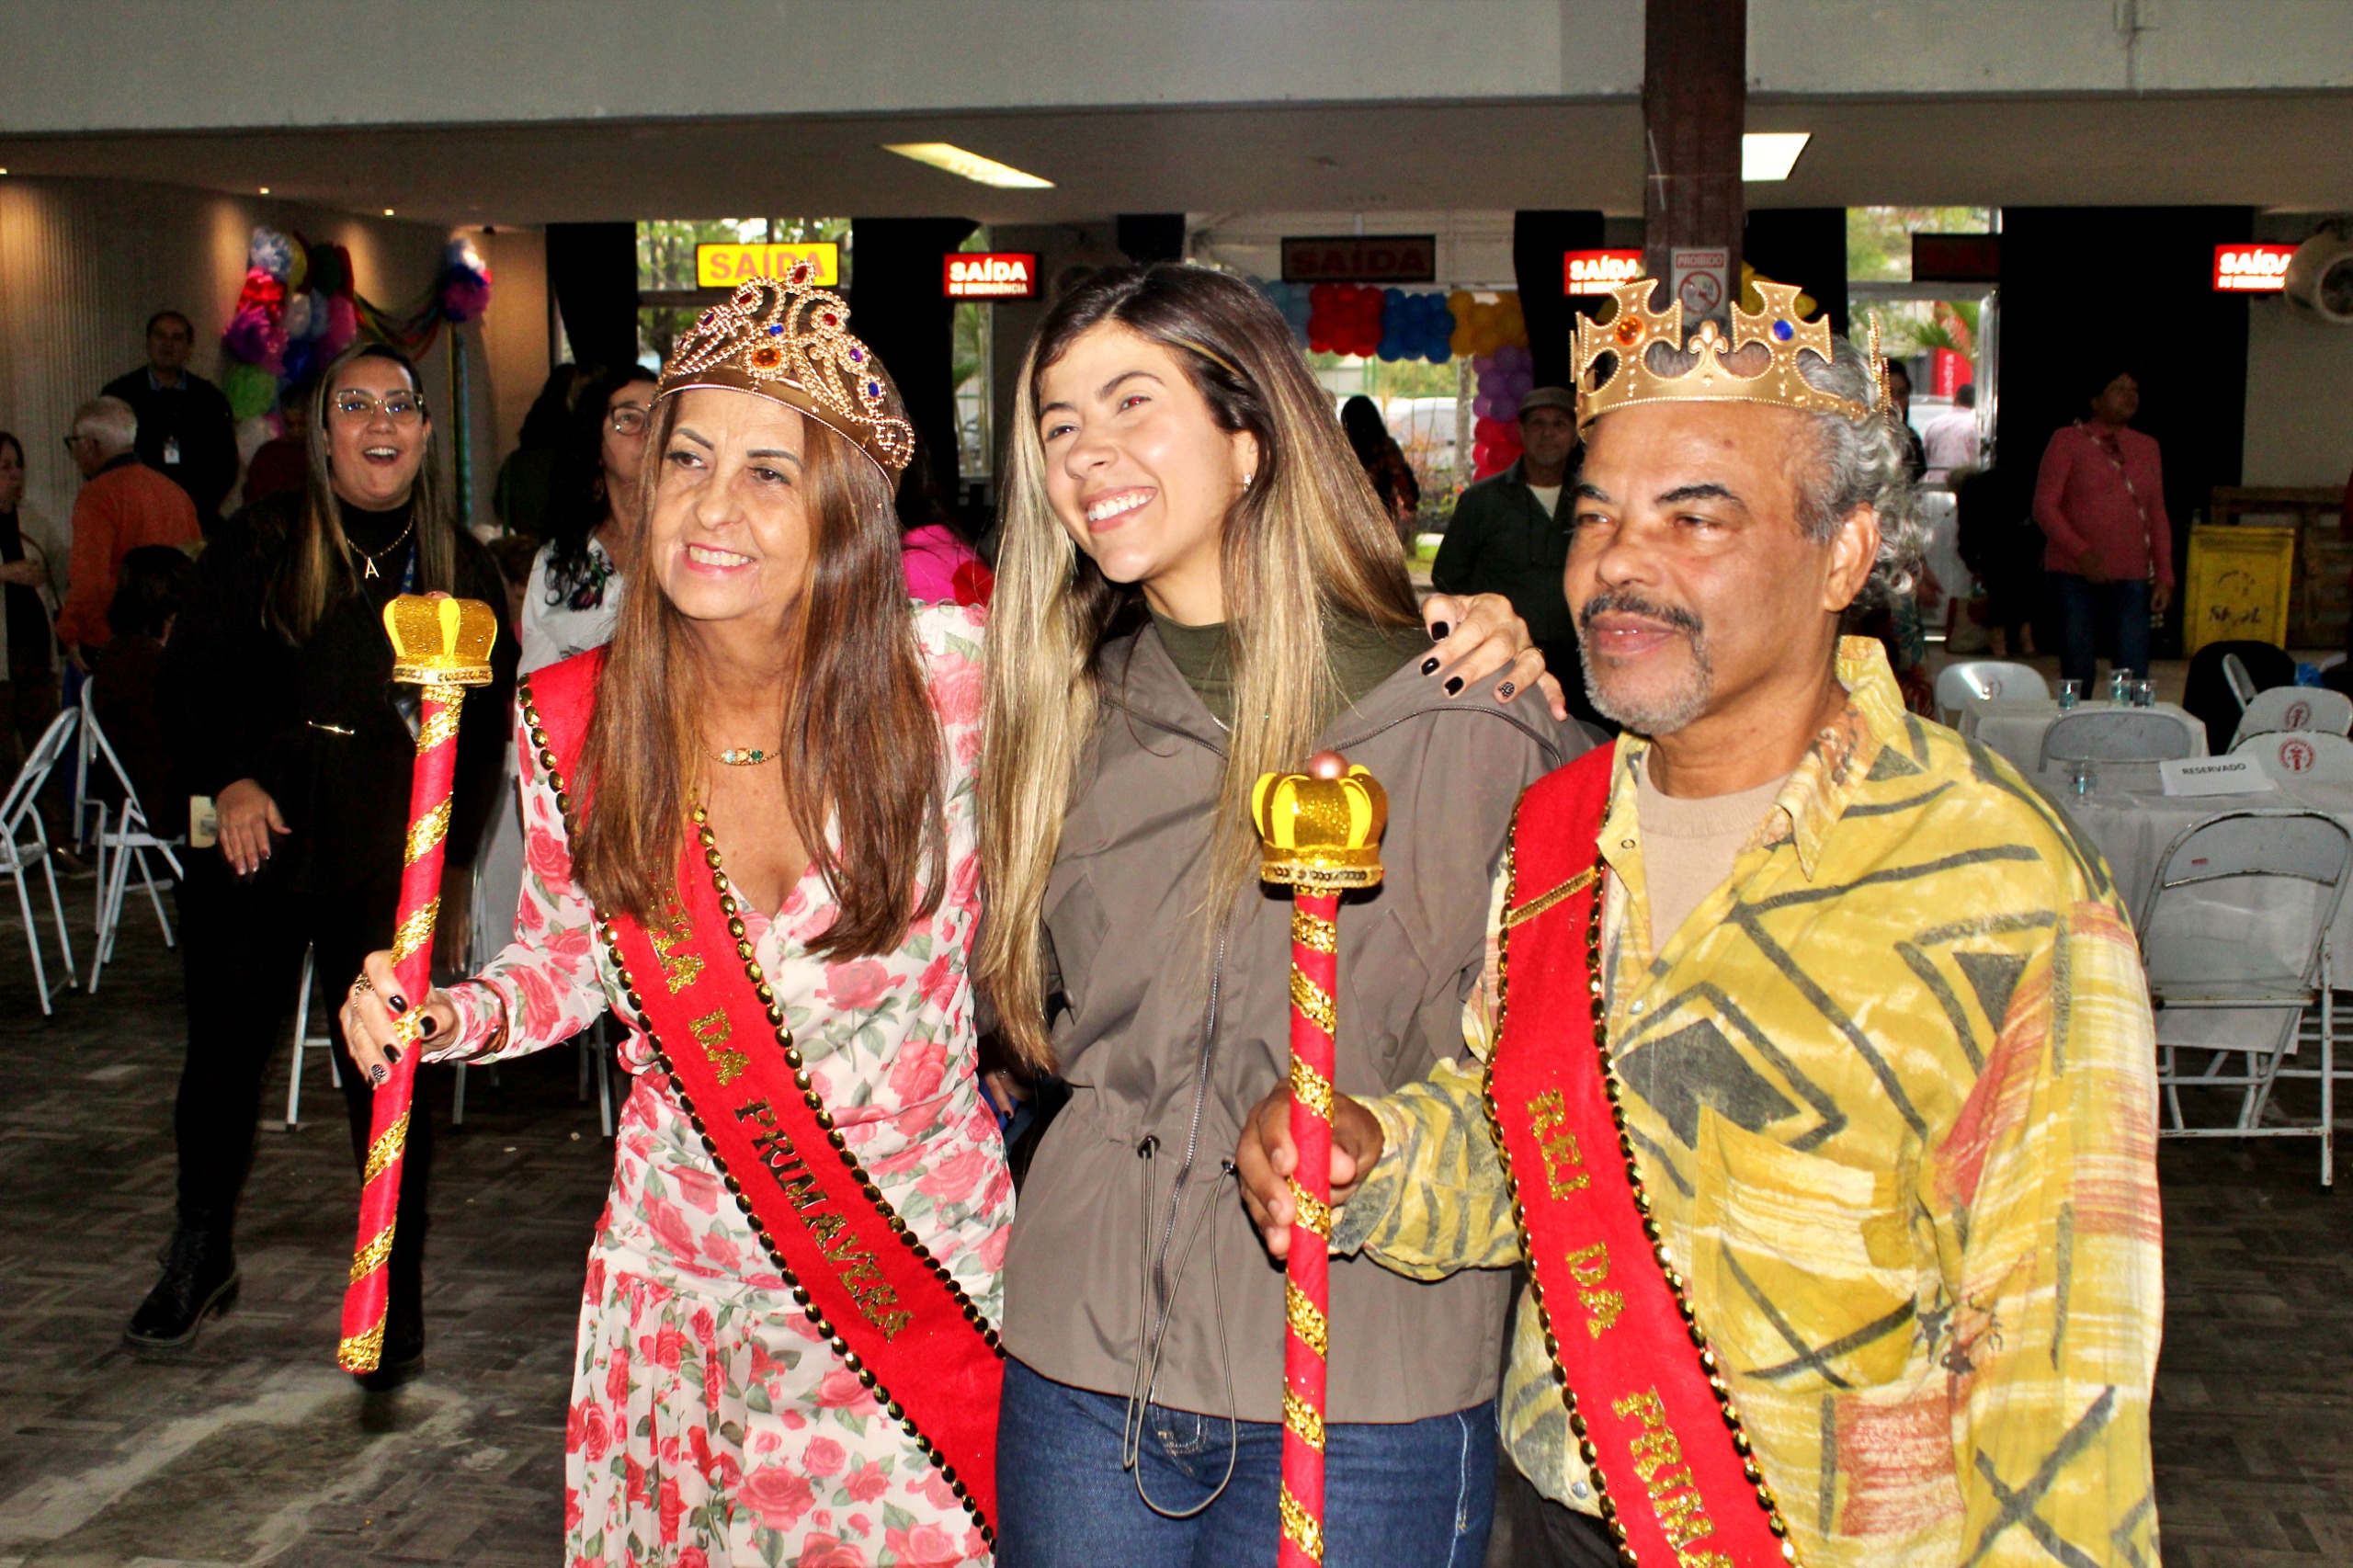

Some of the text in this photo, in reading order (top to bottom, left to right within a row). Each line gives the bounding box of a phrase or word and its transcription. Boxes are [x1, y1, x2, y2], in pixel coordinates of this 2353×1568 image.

[949, 257, 1028, 281] SAÍDA
[365, 557, 380, 579] A
[2182, 763, 2246, 774] RESERVADO
[688, 1007, 915, 1344] DA PRIMAVERA
[1526, 1088, 1591, 1200] REI
[1565, 1240, 1625, 1340] DA
